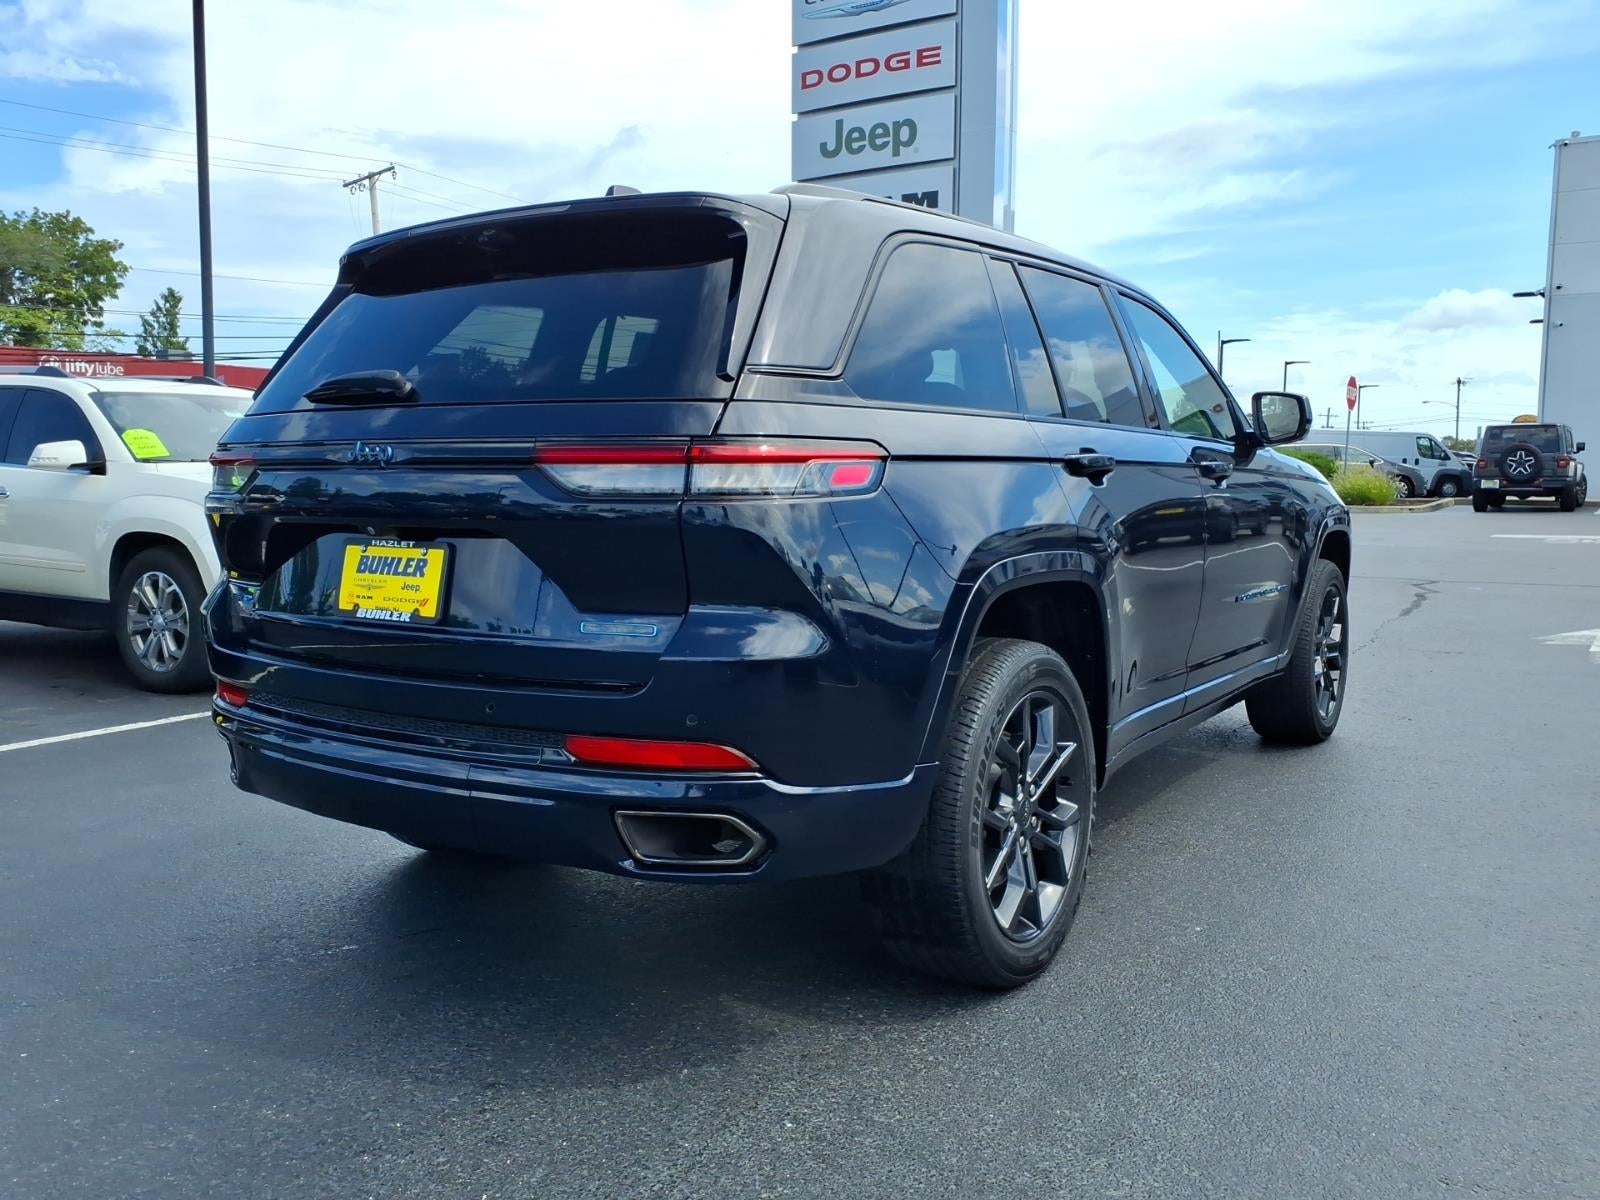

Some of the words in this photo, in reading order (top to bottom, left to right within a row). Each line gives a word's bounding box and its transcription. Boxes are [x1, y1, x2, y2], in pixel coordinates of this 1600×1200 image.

[801, 45, 942, 90] DODGE
[819, 117, 918, 159] Jeep
[65, 359, 94, 376] jiffy
[95, 362, 124, 376] lube
[371, 539, 415, 548] HAZLET
[356, 554, 429, 578] BUHLER
[400, 581, 421, 593] Jeep
[356, 608, 411, 622] BUHLER
